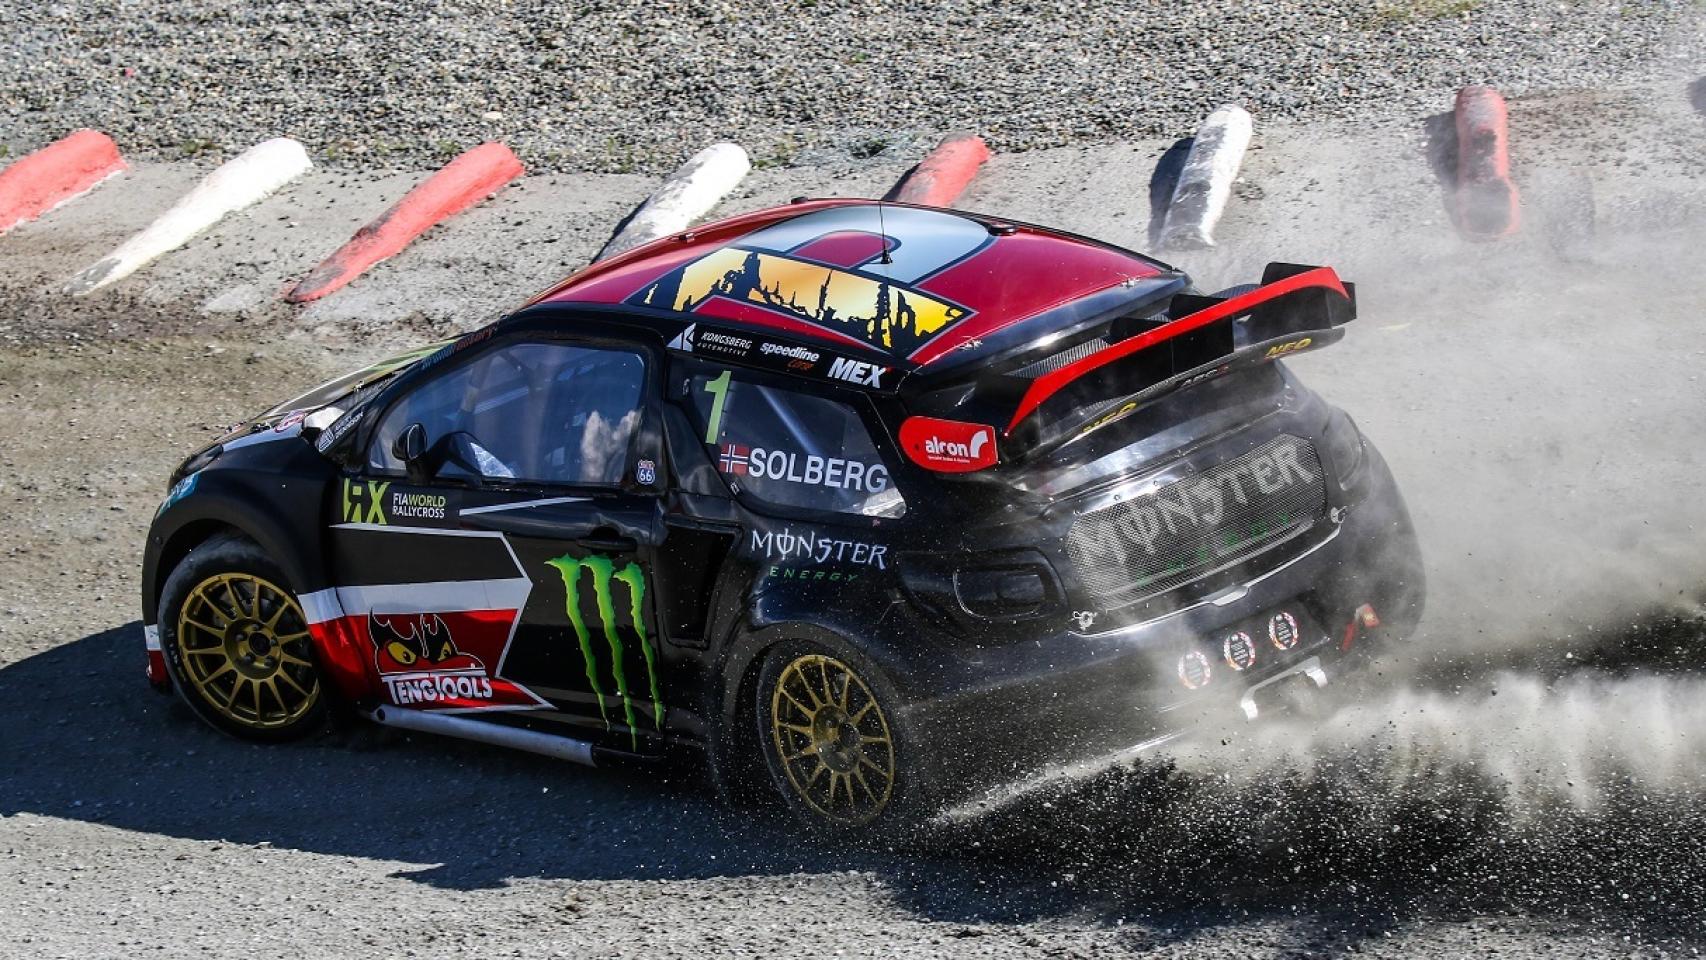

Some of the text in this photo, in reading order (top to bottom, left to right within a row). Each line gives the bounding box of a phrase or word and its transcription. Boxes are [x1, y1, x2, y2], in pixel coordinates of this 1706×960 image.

[701, 331, 752, 349] KONGSBERG
[759, 341, 820, 362] speedline
[826, 357, 887, 388] MEX
[704, 370, 732, 445] 1
[640, 469, 652, 482] 66
[749, 447, 889, 493] SOLBERG
[391, 505, 445, 519] RALLYCROSS
[769, 565, 859, 582] ENERGY
